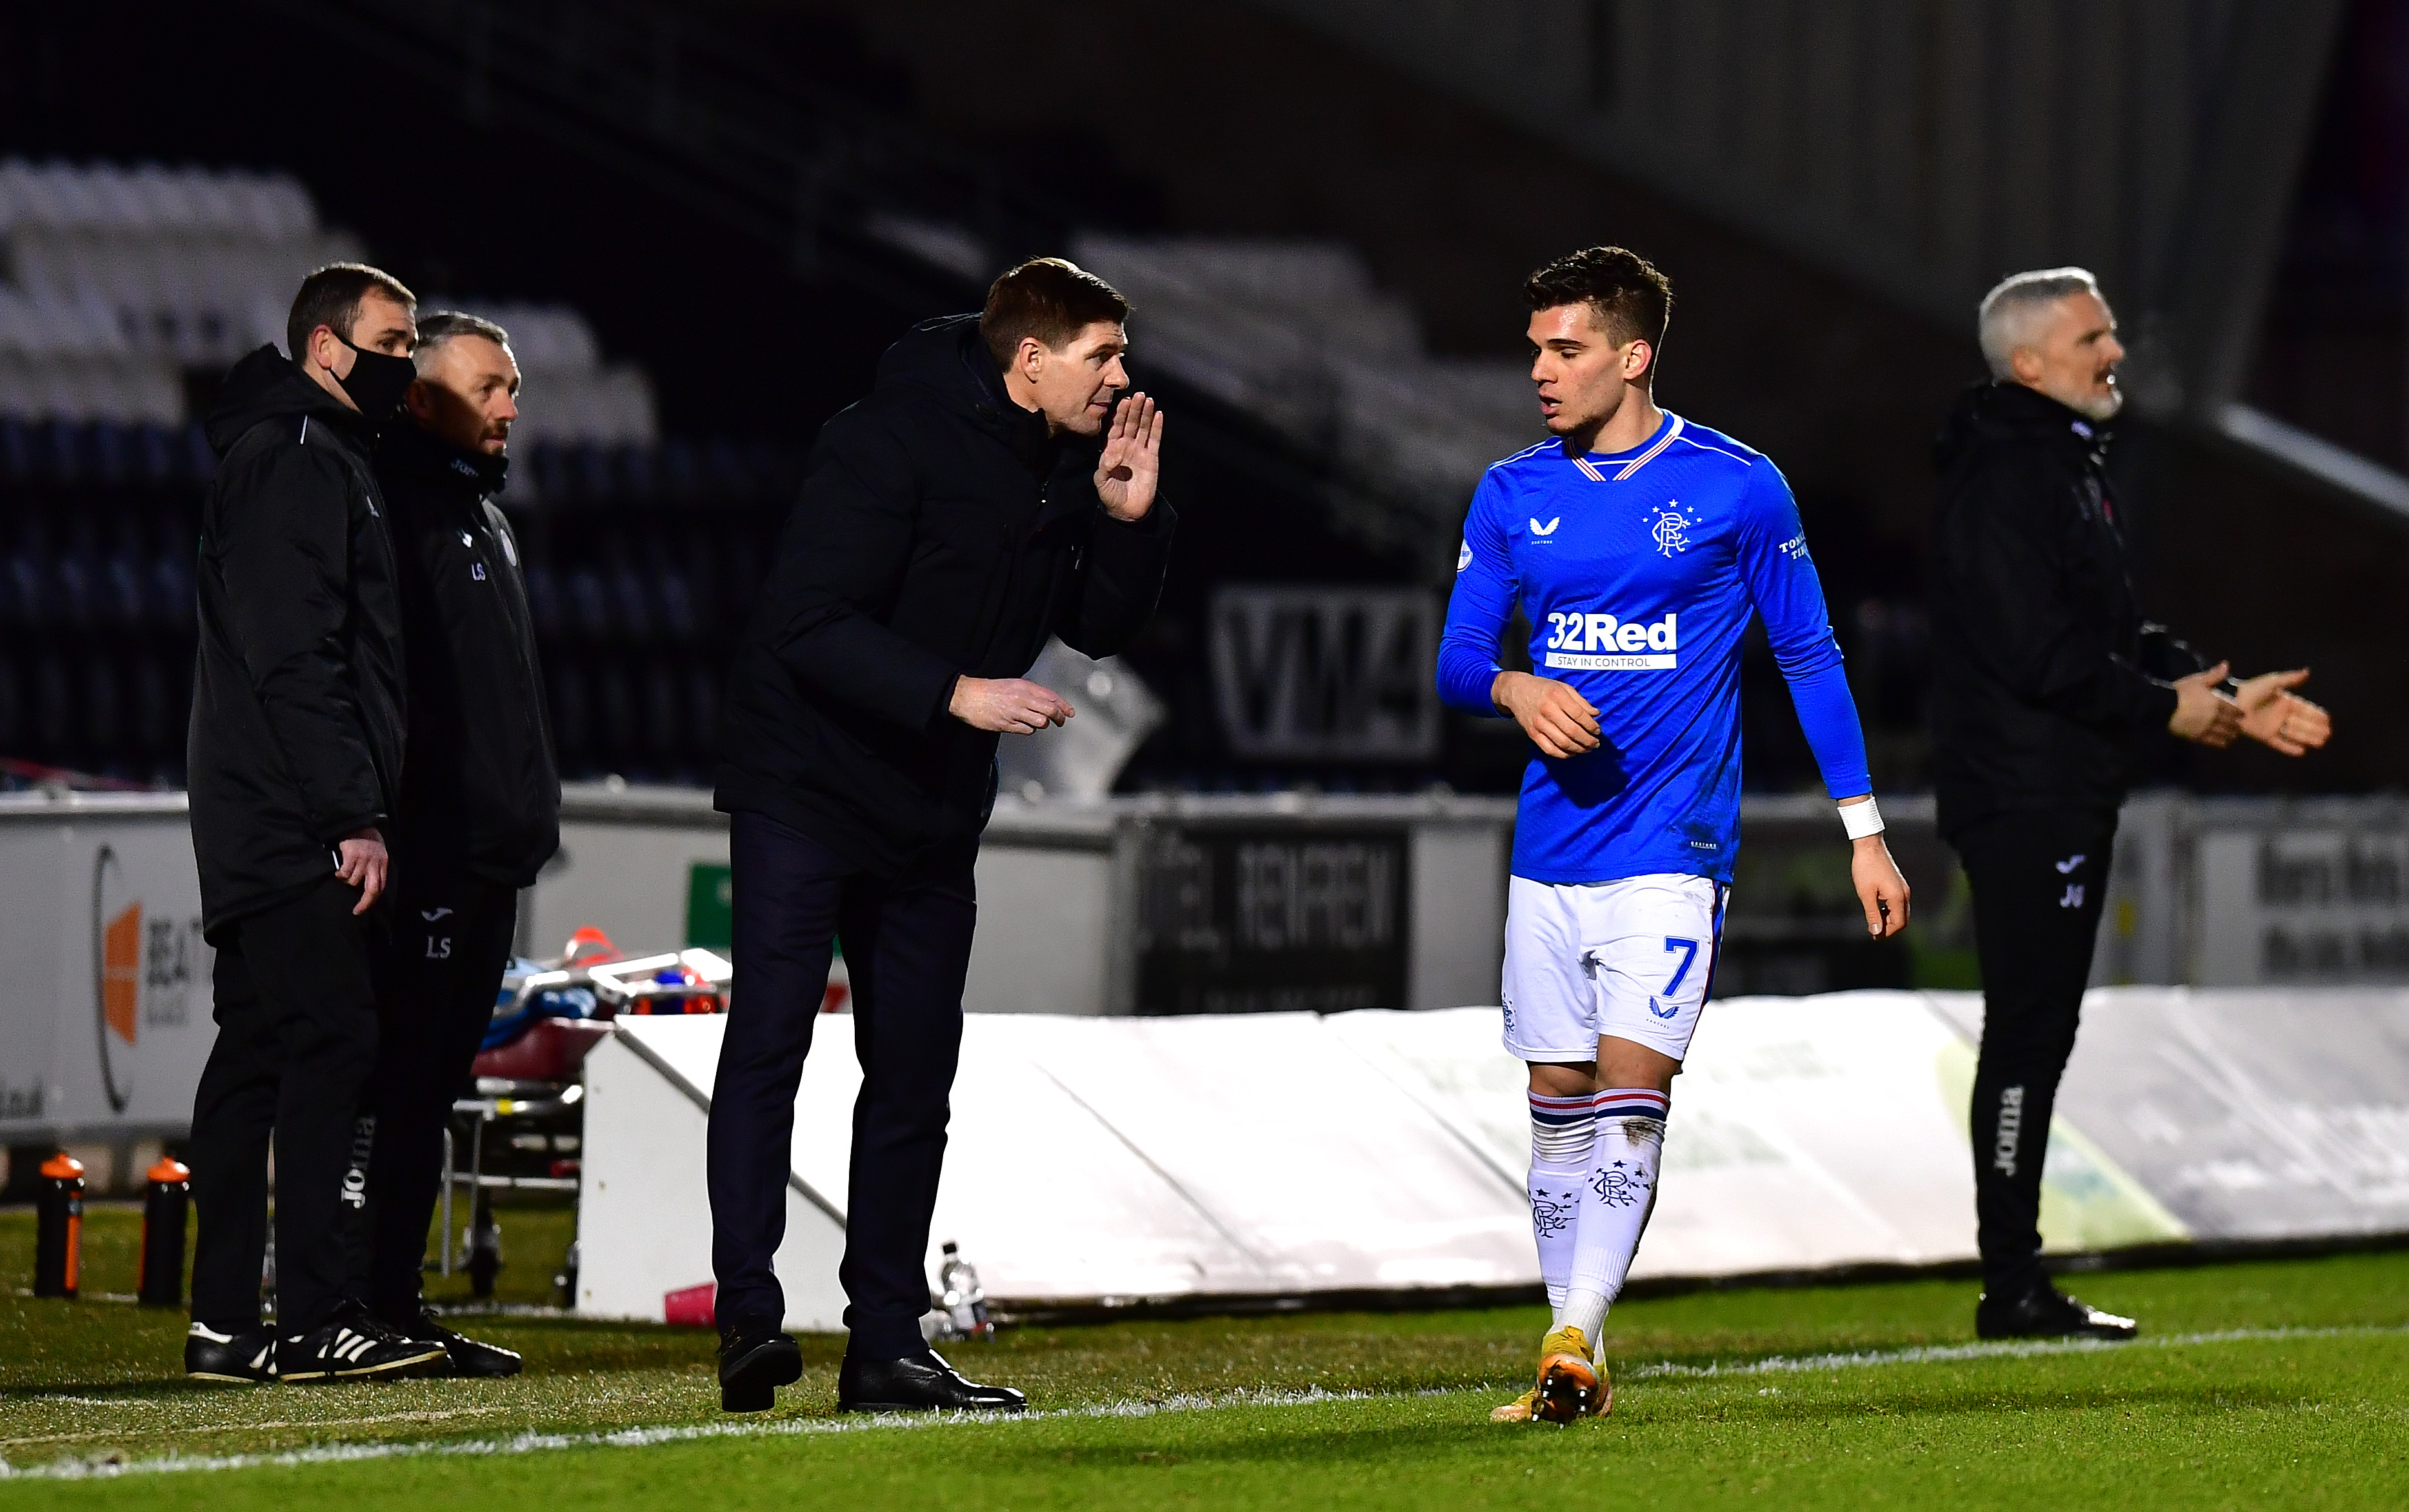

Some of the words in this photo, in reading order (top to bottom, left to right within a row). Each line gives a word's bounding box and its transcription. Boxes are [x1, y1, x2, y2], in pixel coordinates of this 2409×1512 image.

[1548, 612, 1677, 652] 32Red
[1557, 656, 1578, 666] STAY
[1581, 658, 1592, 666] IN
[1595, 658, 1651, 667] CONTROL
[426, 936, 452, 959] LS
[1661, 935, 1699, 999] 7
